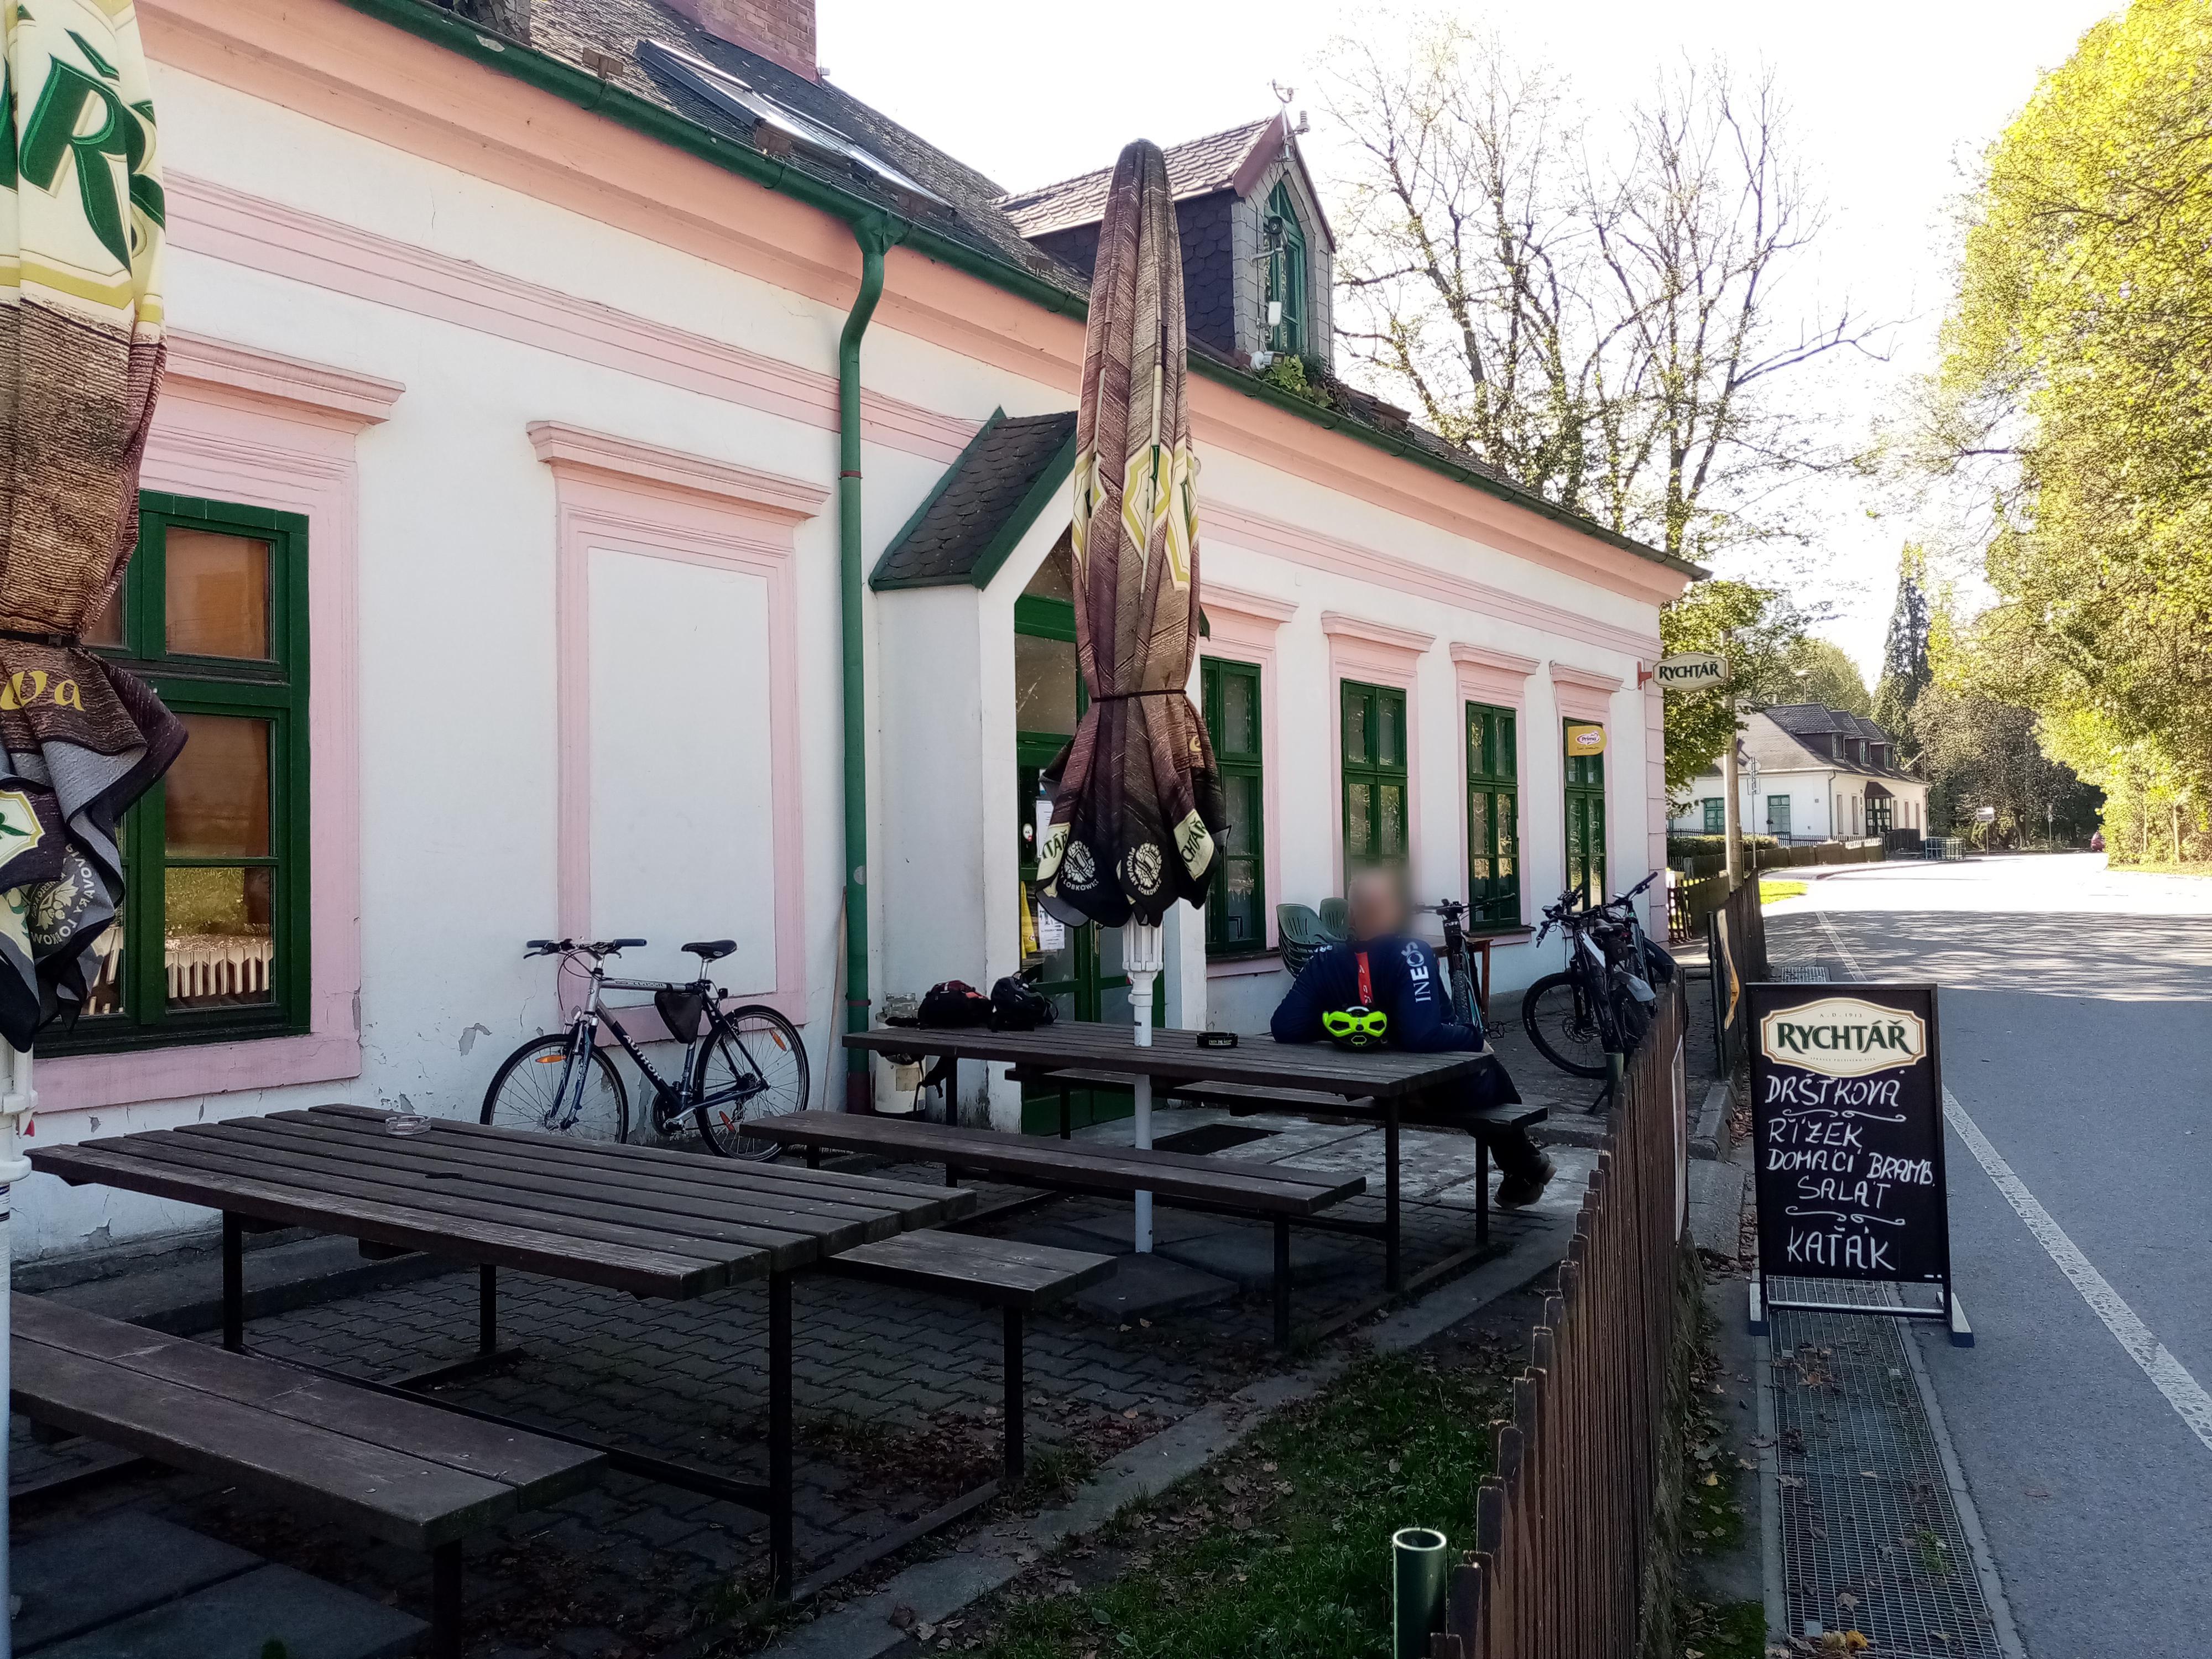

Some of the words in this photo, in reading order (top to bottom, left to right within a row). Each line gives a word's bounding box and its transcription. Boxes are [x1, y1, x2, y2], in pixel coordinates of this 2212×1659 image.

[1659, 660, 1724, 681] RYCHTÁŘ
[1401, 941, 1431, 1003] INEOS
[623, 1034, 662, 1081] AUTHOR
[1776, 1019, 1915, 1055] RYCHTÁŘ
